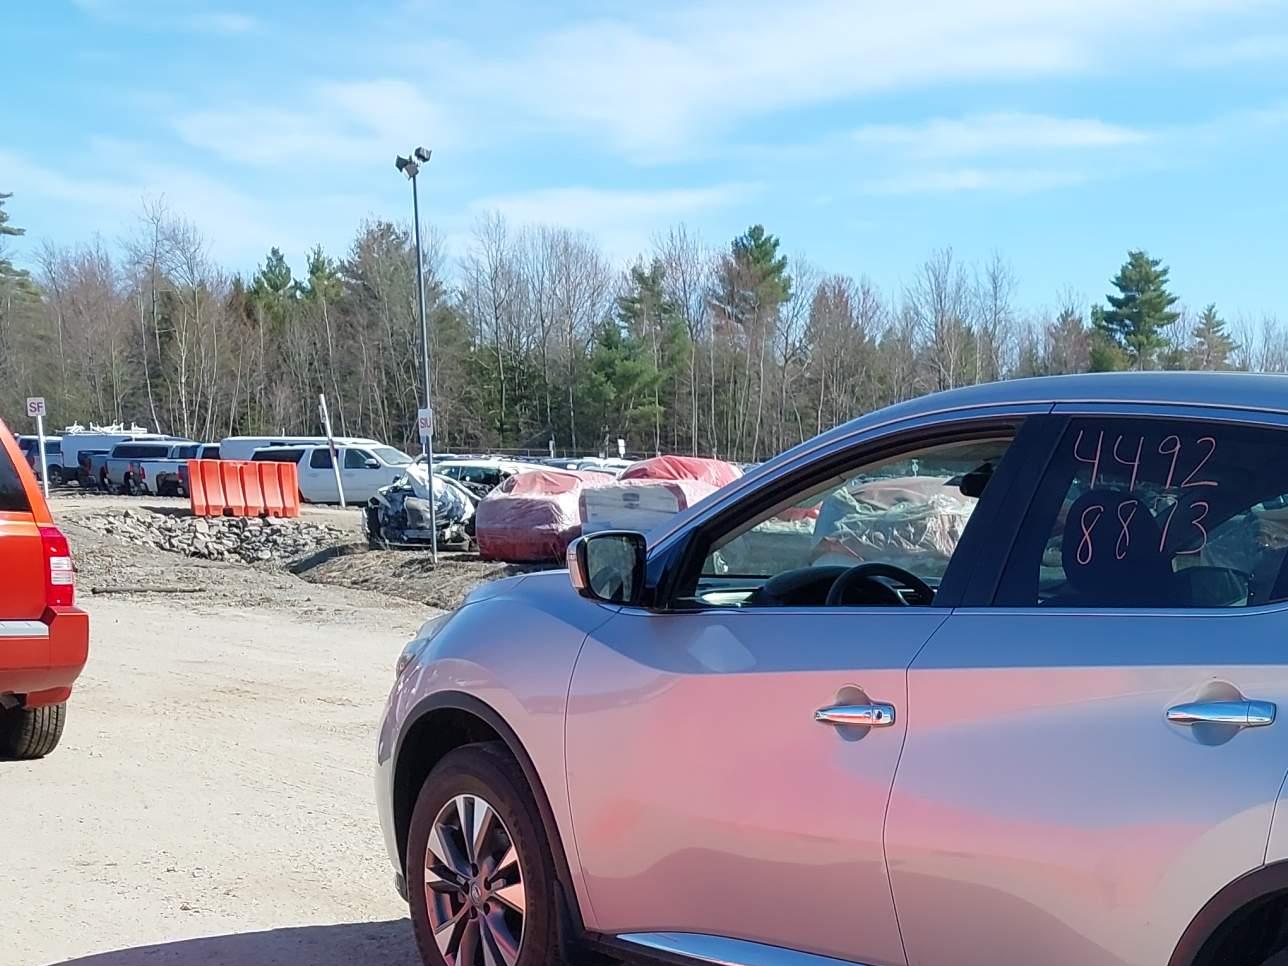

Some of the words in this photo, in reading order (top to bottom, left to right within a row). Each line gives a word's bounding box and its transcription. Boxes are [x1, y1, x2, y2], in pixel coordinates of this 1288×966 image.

[29, 402, 43, 413] SF
[1073, 429, 1219, 492] 4492
[1076, 499, 1209, 566] 8873
